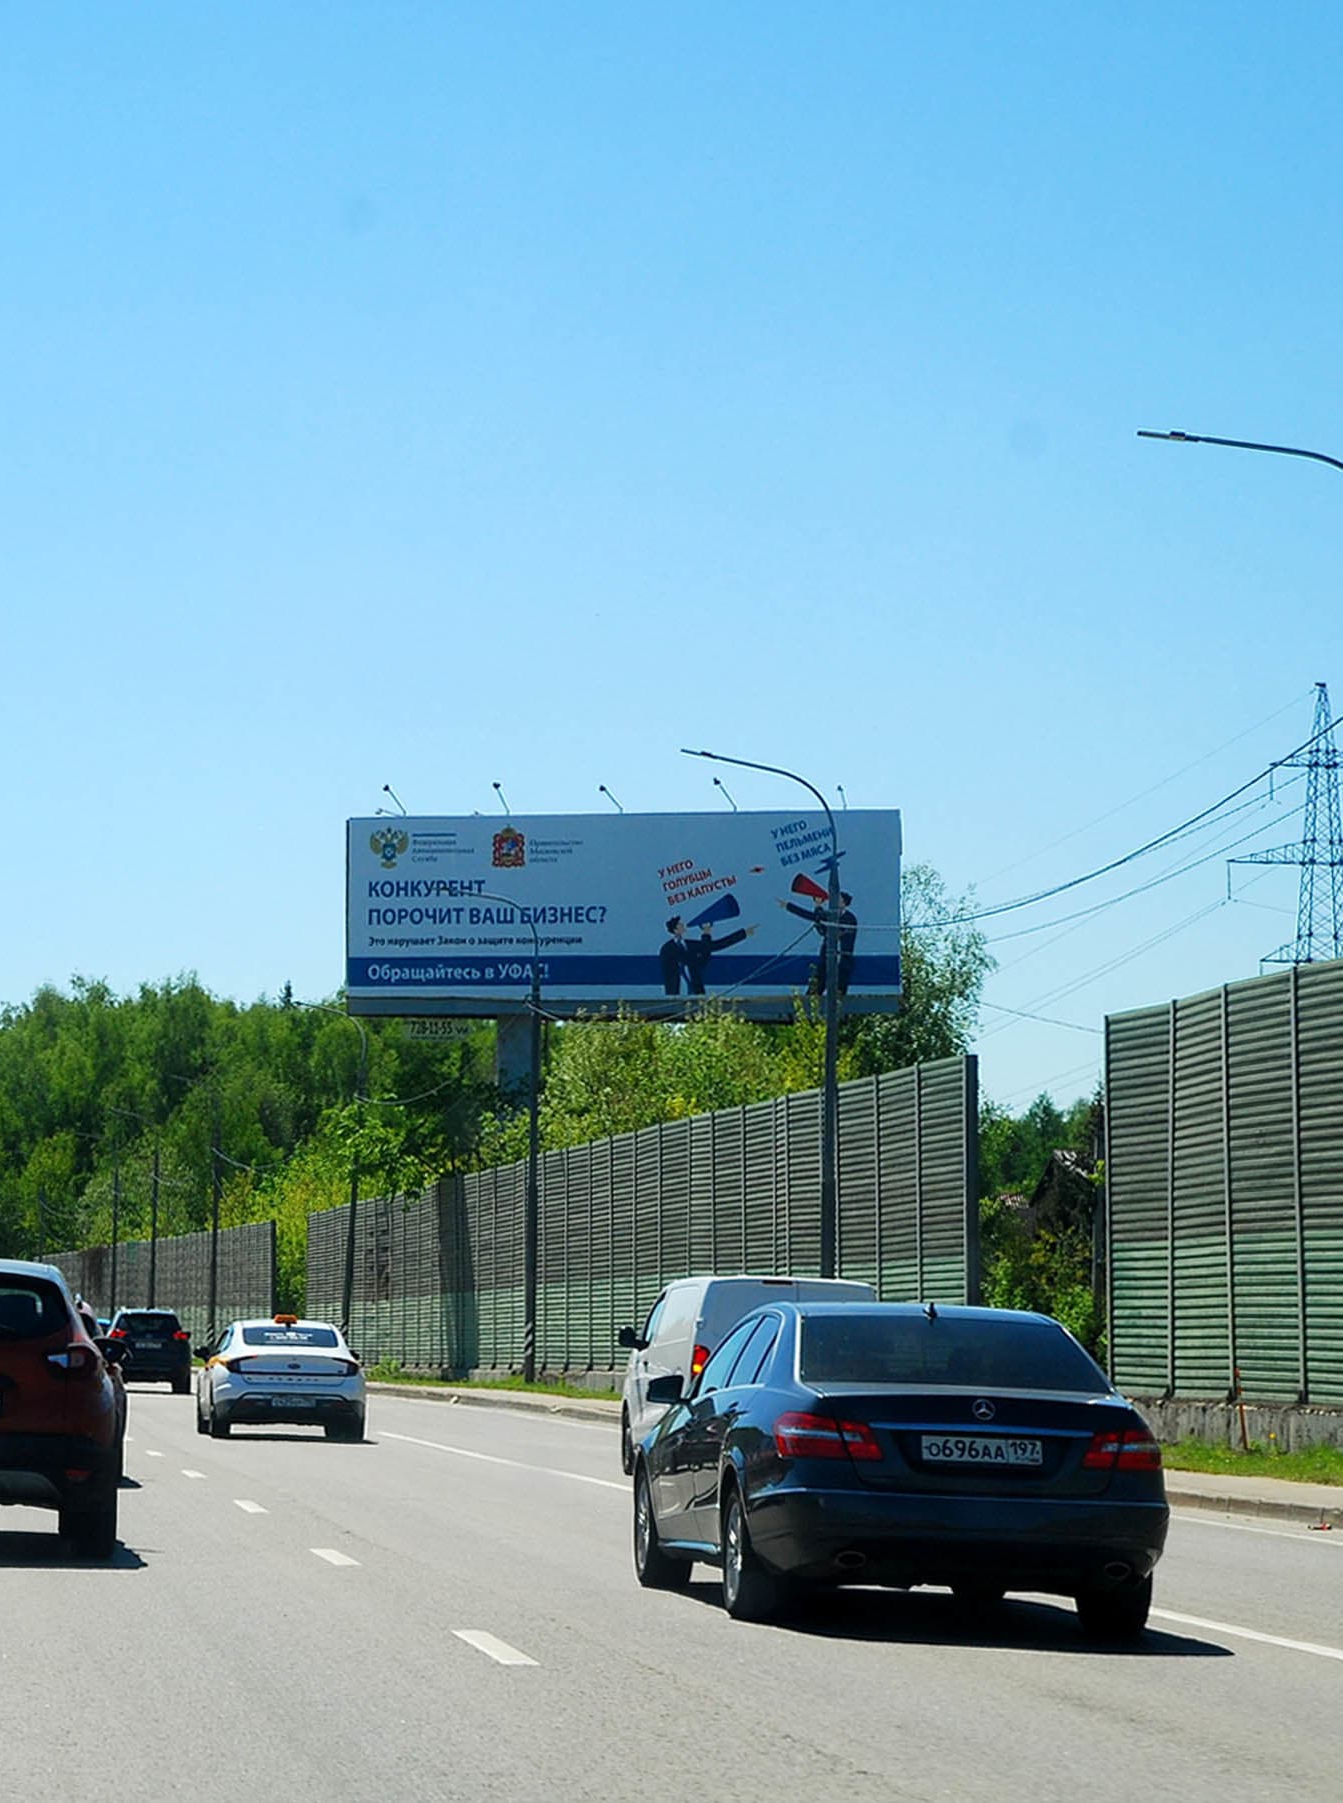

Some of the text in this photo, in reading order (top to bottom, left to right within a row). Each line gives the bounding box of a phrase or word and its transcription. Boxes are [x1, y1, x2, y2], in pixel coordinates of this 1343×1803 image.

[769, 819, 807, 839] У НЕГО
[775, 826, 834, 853] ПЕЛЬМЕНИ
[780, 842, 832, 867] БЕЗ МЯСА
[657, 858, 694, 878] У НЕГО
[368, 879, 486, 898] КОНКУРЕНТ
[662, 867, 713, 892] ГОЛУБЦЫ
[666, 874, 737, 906] БЕЗ КАПУСТЫ
[368, 905, 607, 926] ПОРОЧИТ ВАШ БИЗНЕС?
[368, 937, 386, 946] Это
[387, 937, 435, 948] нарушает
[437, 936, 466, 946] Закон
[468, 937, 476, 945] о
[478, 937, 514, 948] защите
[367, 963, 481, 982] Обращайтесь
[484, 967, 495, 979] в
